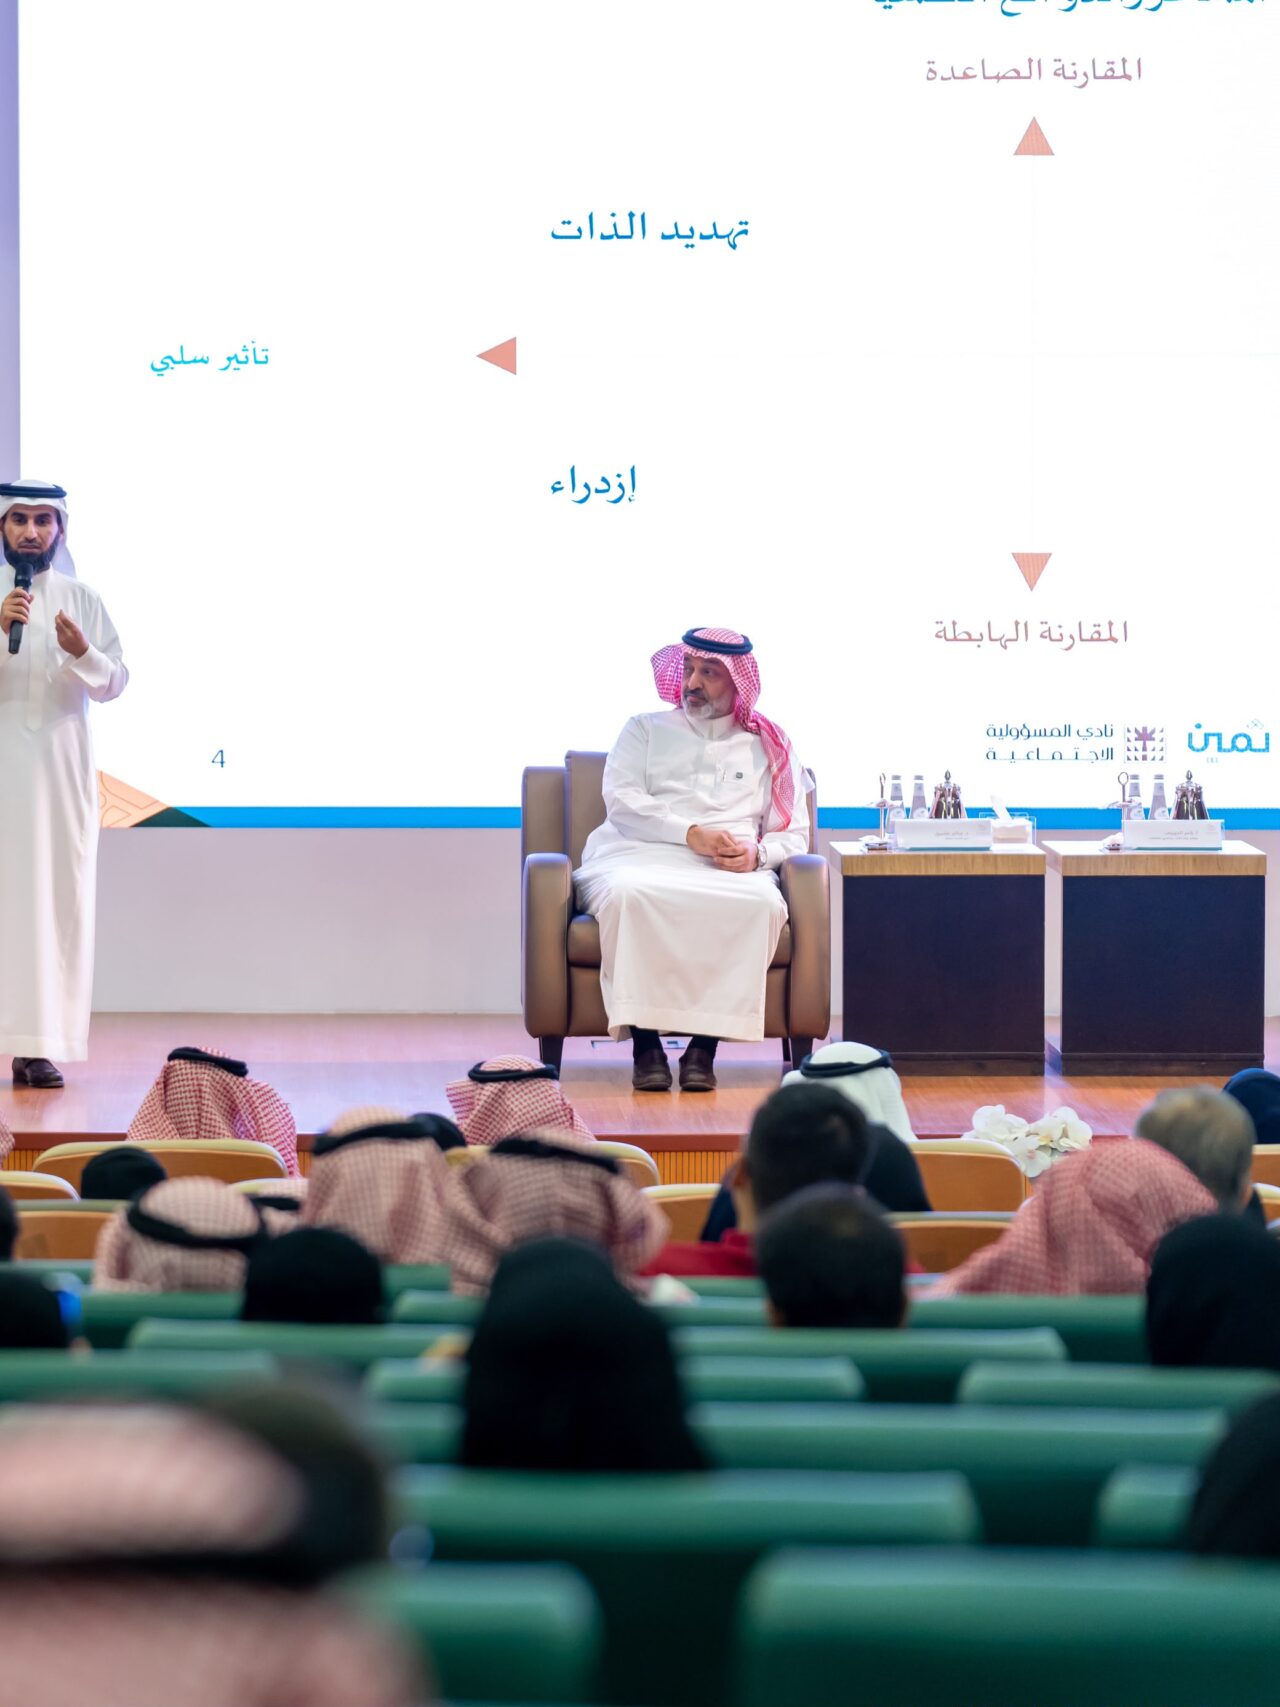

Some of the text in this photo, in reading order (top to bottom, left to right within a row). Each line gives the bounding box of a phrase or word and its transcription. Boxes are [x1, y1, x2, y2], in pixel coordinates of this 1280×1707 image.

[926, 57, 1142, 89] المقارنة الصاعدة
[550, 211, 750, 251] تهديد الذات
[150, 340, 269, 377] تأثير سلبي
[550, 464, 636, 505] إزدراء
[934, 619, 1128, 652] المقارنة الهابطة
[985, 723, 1114, 741] نادي المسؤولية
[211, 749, 226, 769] 4
